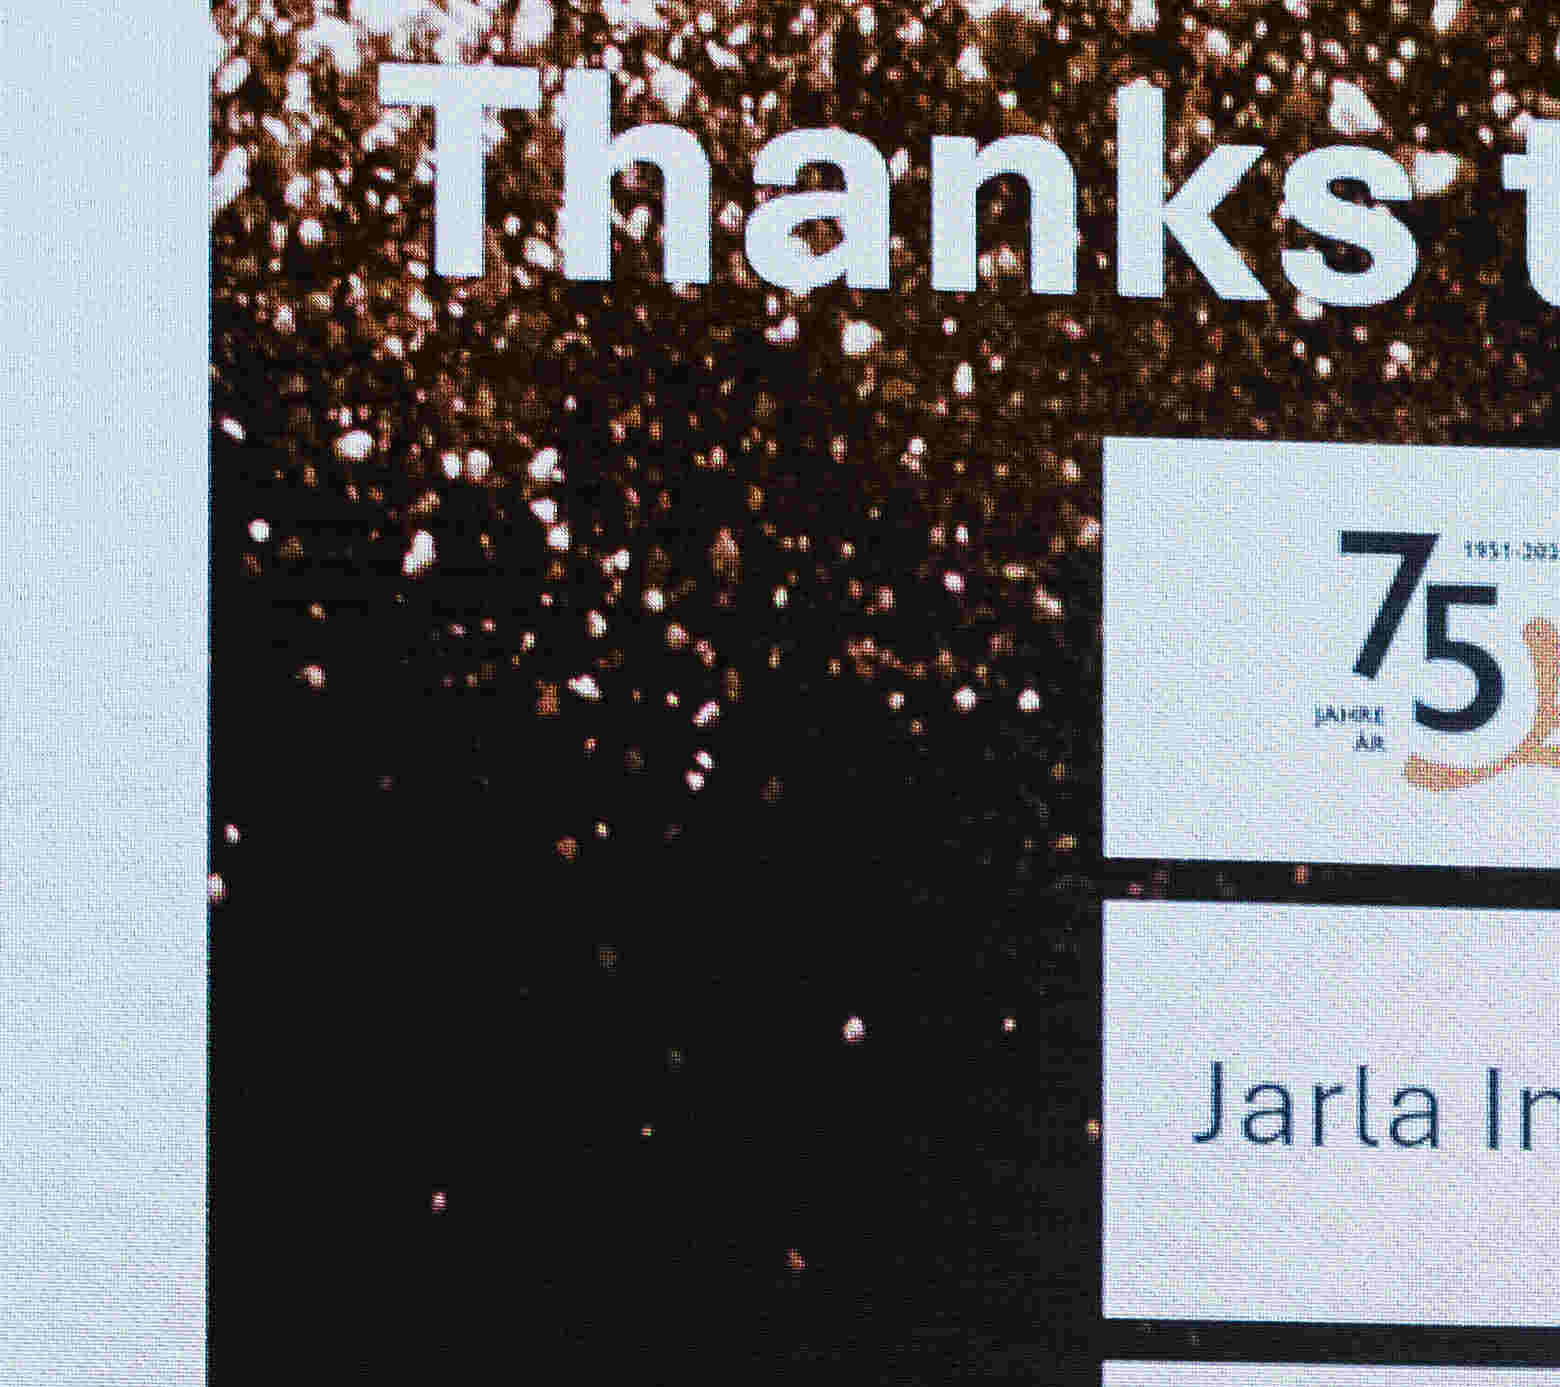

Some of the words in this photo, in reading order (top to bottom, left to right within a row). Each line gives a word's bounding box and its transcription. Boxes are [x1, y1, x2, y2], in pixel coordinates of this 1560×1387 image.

[377, 62, 1418, 310] Thanks
[1337, 529, 1504, 733] 75
[1193, 1061, 1439, 1148] Jarla
